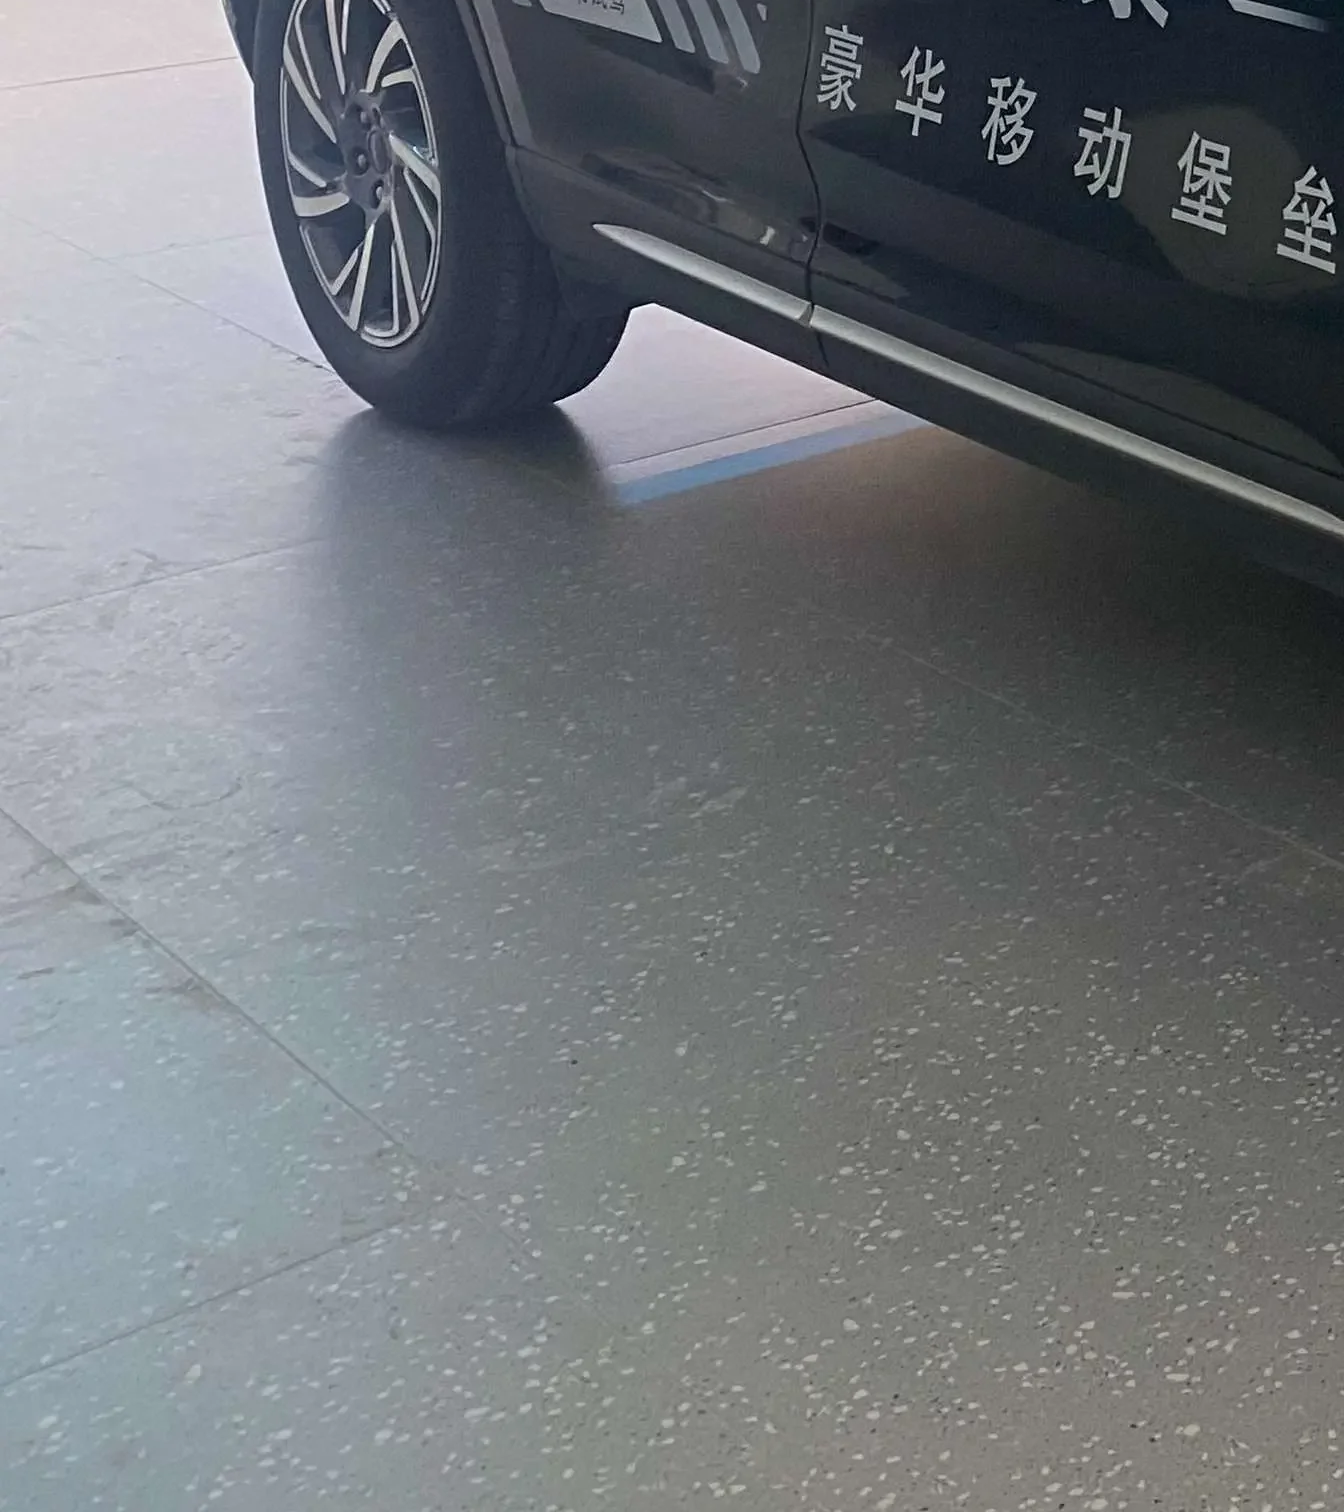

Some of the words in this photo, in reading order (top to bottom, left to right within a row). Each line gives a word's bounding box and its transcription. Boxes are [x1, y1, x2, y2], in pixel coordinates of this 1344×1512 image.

[817, 24, 1336, 274] 豪华移动堡垒
